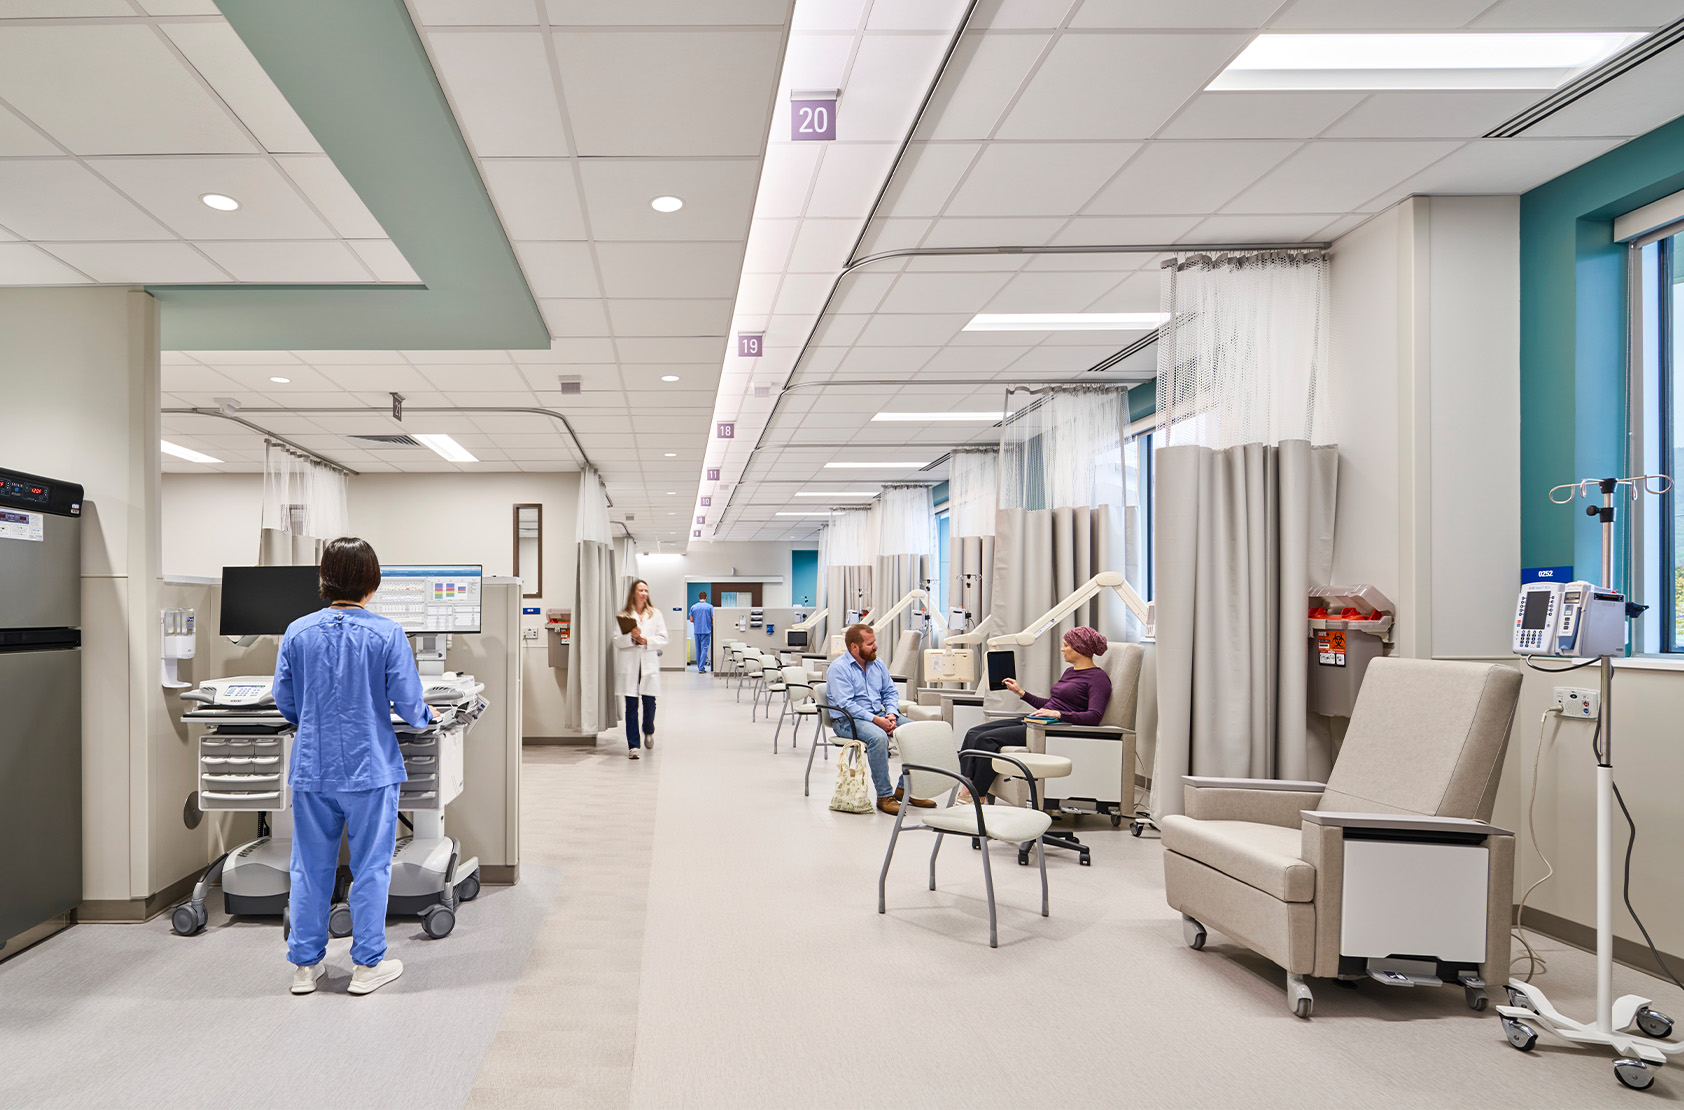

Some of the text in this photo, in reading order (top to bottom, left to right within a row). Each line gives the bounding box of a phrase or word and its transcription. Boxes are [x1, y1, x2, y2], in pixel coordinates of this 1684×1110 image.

[798, 107, 828, 133] 20
[742, 339, 758, 354] 19
[395, 401, 401, 417] 21
[720, 425, 731, 436] 18
[709, 471, 717, 479] 11
